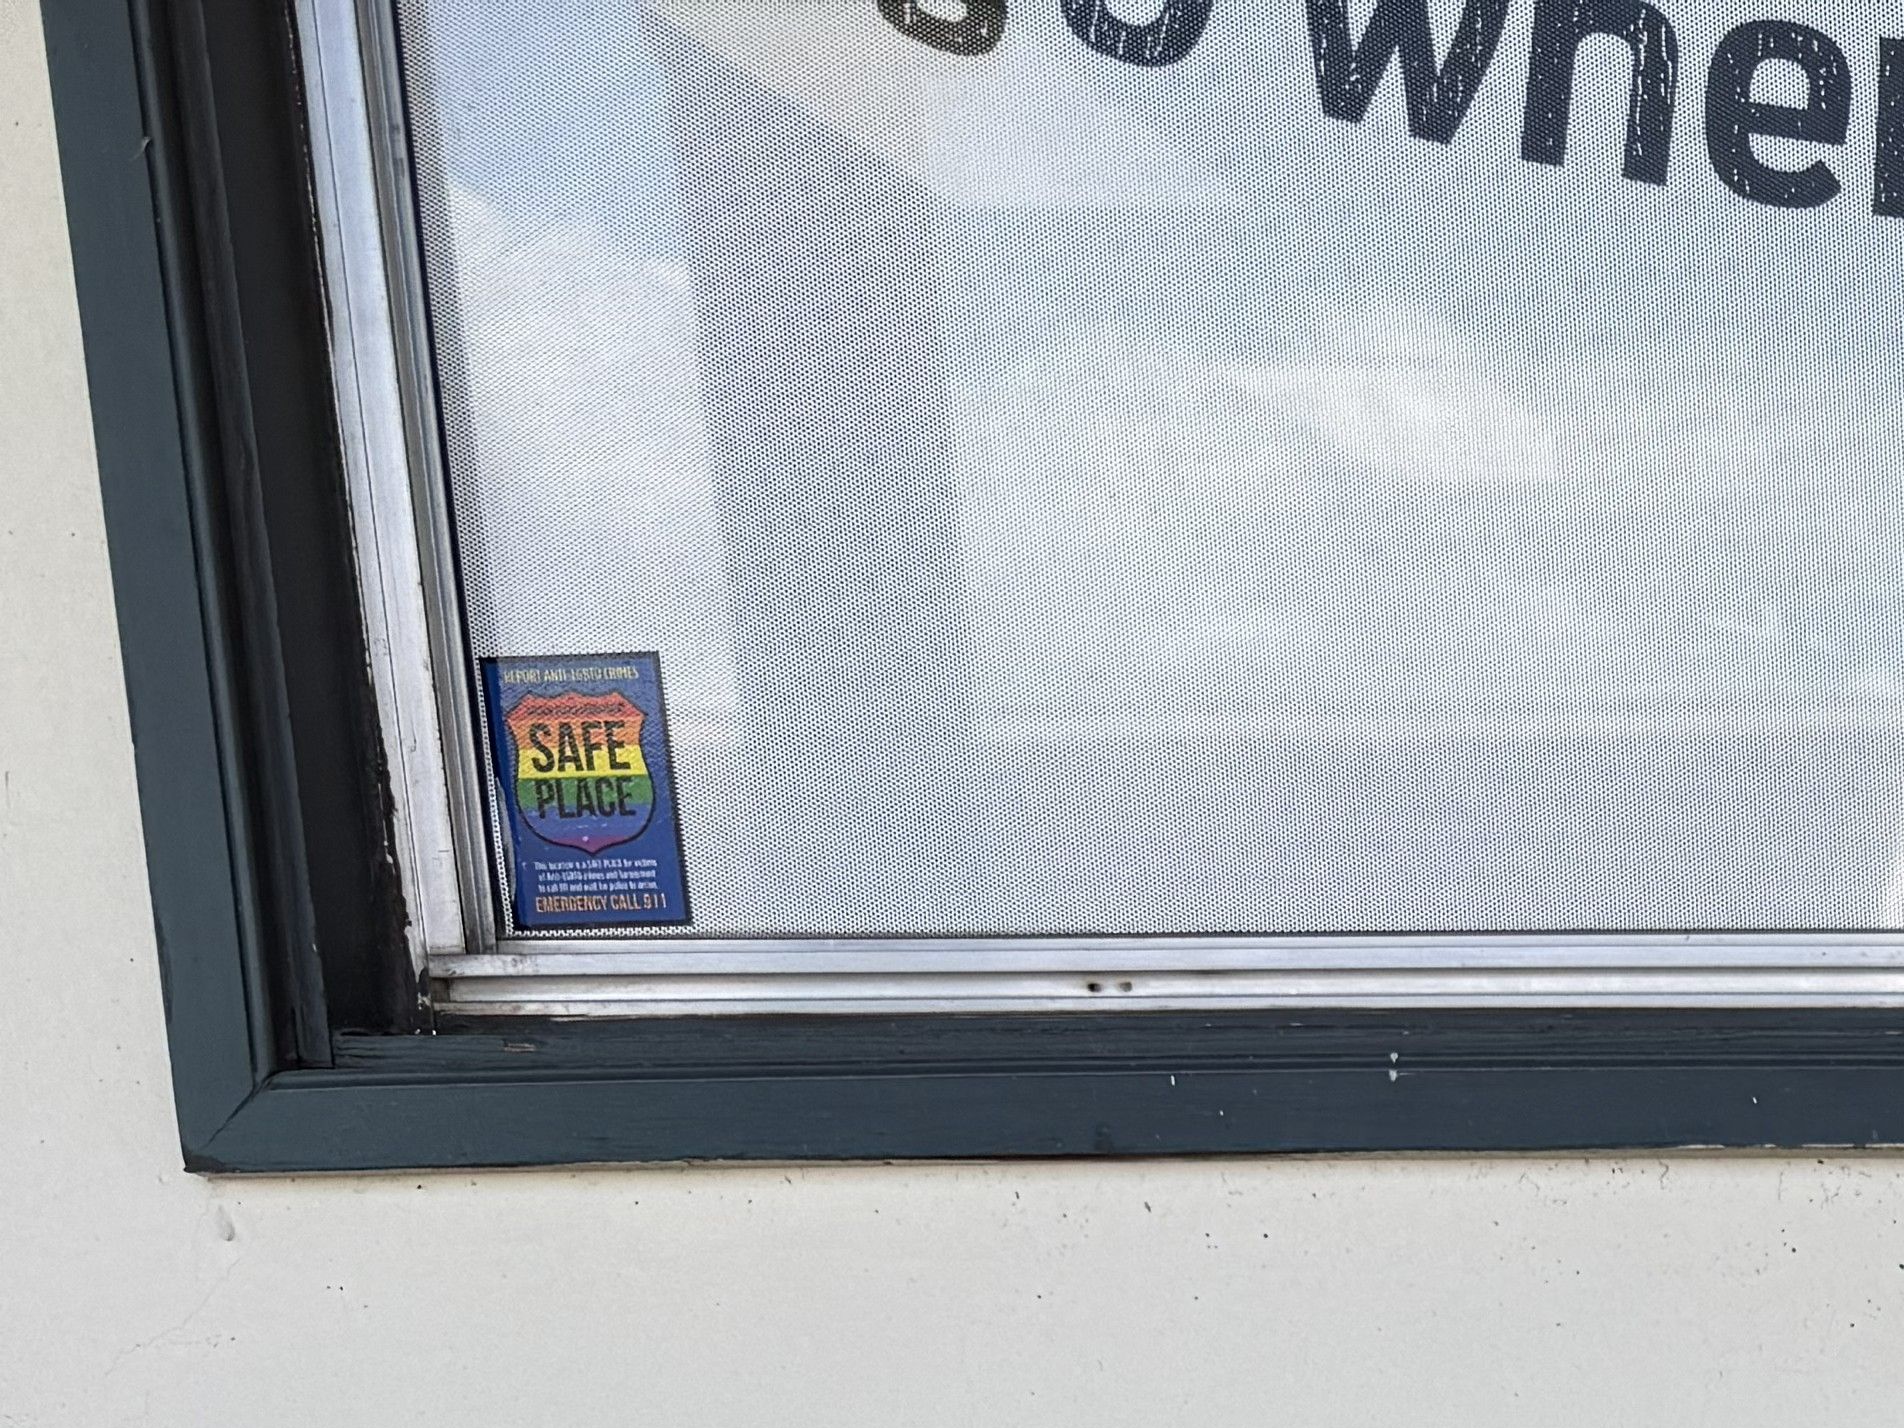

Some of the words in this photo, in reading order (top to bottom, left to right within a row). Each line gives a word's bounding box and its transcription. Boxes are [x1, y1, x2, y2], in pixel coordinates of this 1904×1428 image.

[530, 721, 631, 773] SAFE
[535, 777, 636, 819] PLACE
[609, 893, 641, 911] CALL
[643, 892, 667, 910] 911
